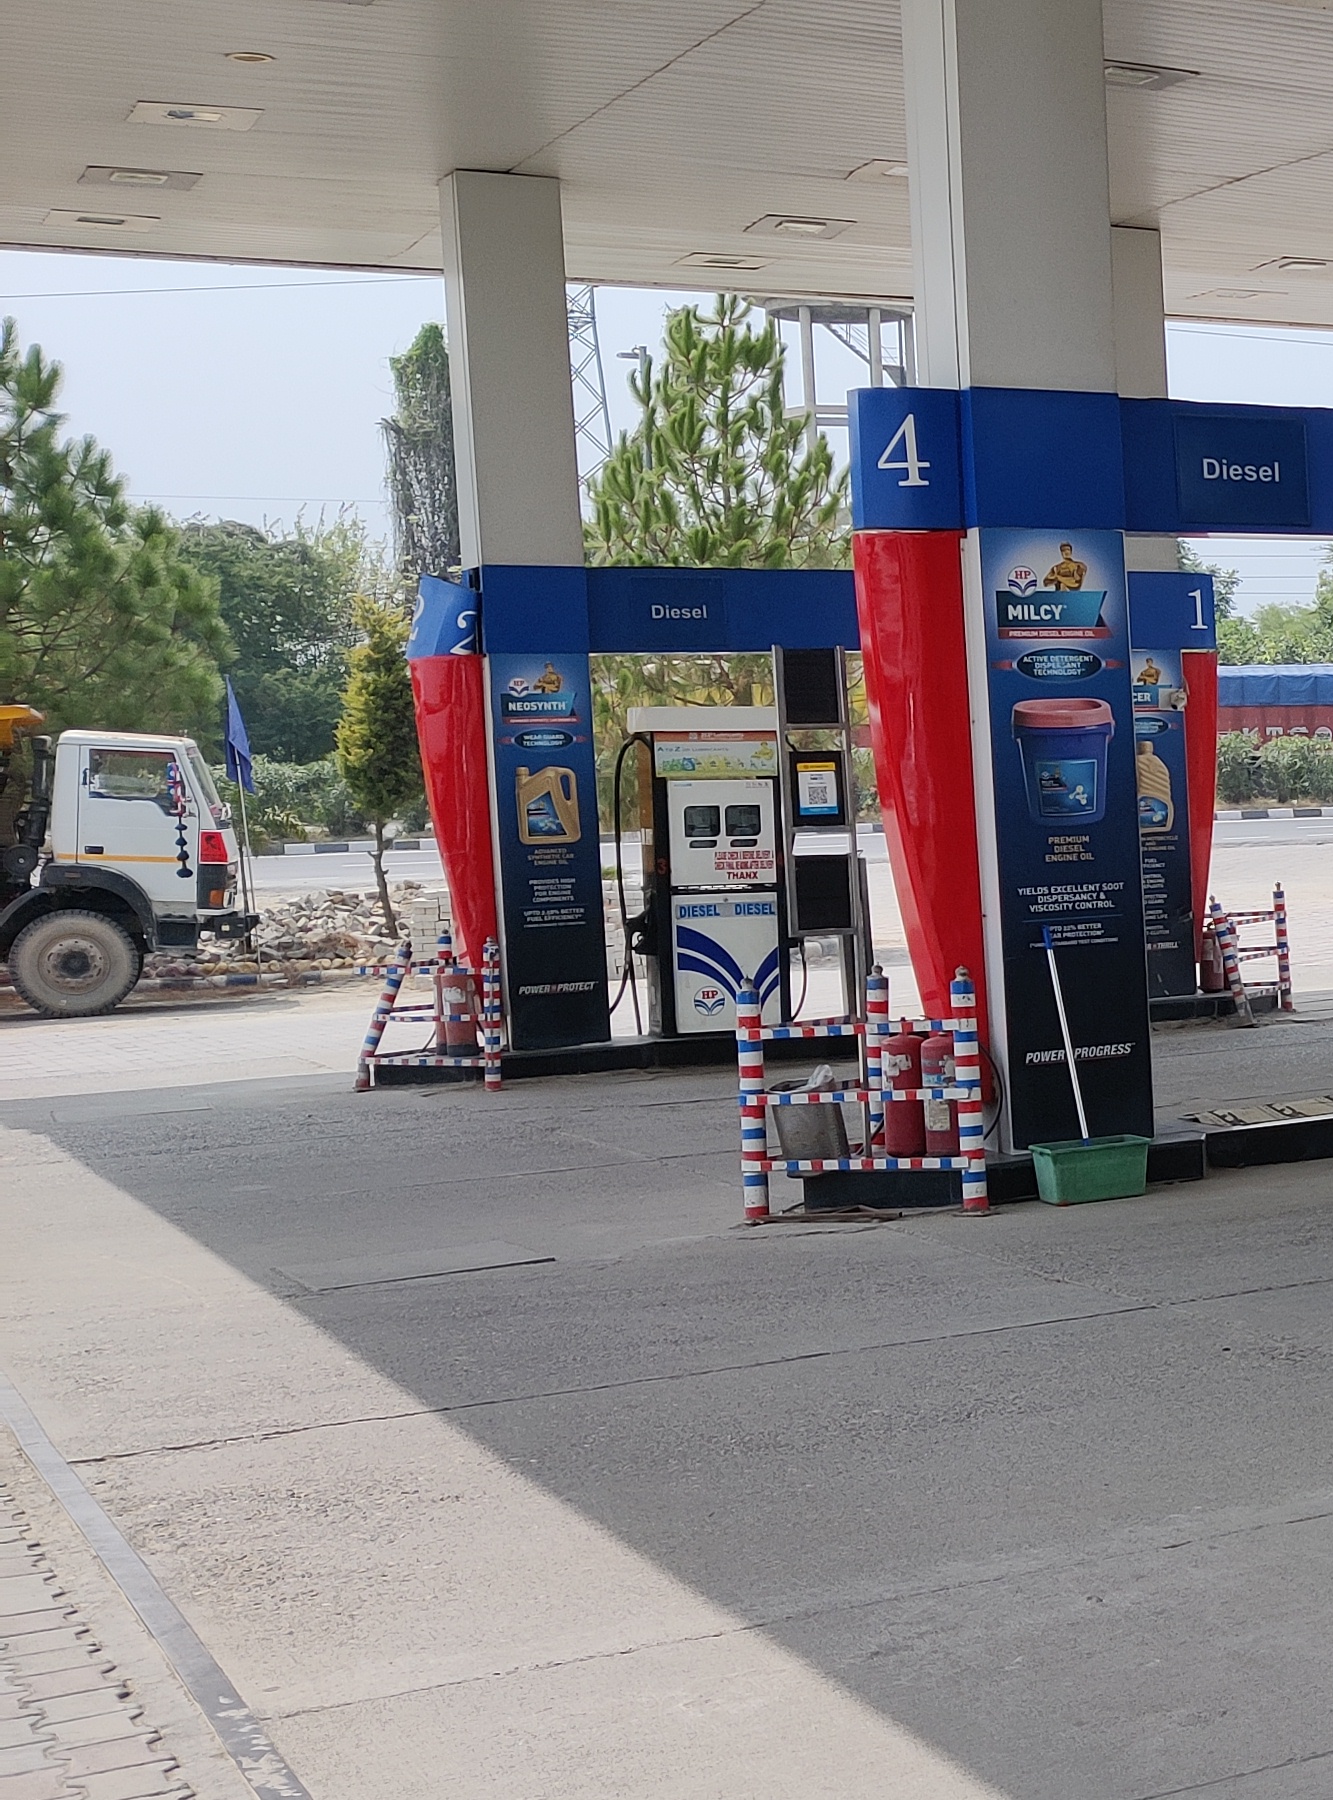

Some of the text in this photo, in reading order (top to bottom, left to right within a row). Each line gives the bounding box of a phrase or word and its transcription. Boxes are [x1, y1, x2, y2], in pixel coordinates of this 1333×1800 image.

[877, 414, 930, 487] 4
[1203, 458, 1281, 482] Diesel
[1015, 570, 1032, 580] HP
[650, 604, 708, 621] Diesel
[1008, 604, 1063, 620] MILCY
[1188, 589, 1209, 630] 1
[1132, 692, 1151, 702] CER
[508, 701, 566, 711] NEOSYNTH
[1048, 835, 1090, 845] PREMIUM
[1054, 845, 1085, 854] DIESEL
[1045, 852, 1095, 863] ENGINE OIL
[726, 871, 759, 880] THANX
[1017, 882, 1125, 896] YIELDS EXCELLENT SOOT
[1037, 893, 1098, 904] DISPERSANCY
[680, 903, 776, 918] DIESEL DIESEL
[1029, 900, 1116, 913] VISCOSITY CONTROL
[519, 981, 595, 996] POWER PROTECT
[702, 990, 719, 1000] HP
[1026, 1043, 1132, 1064] POWER PROGRESS
